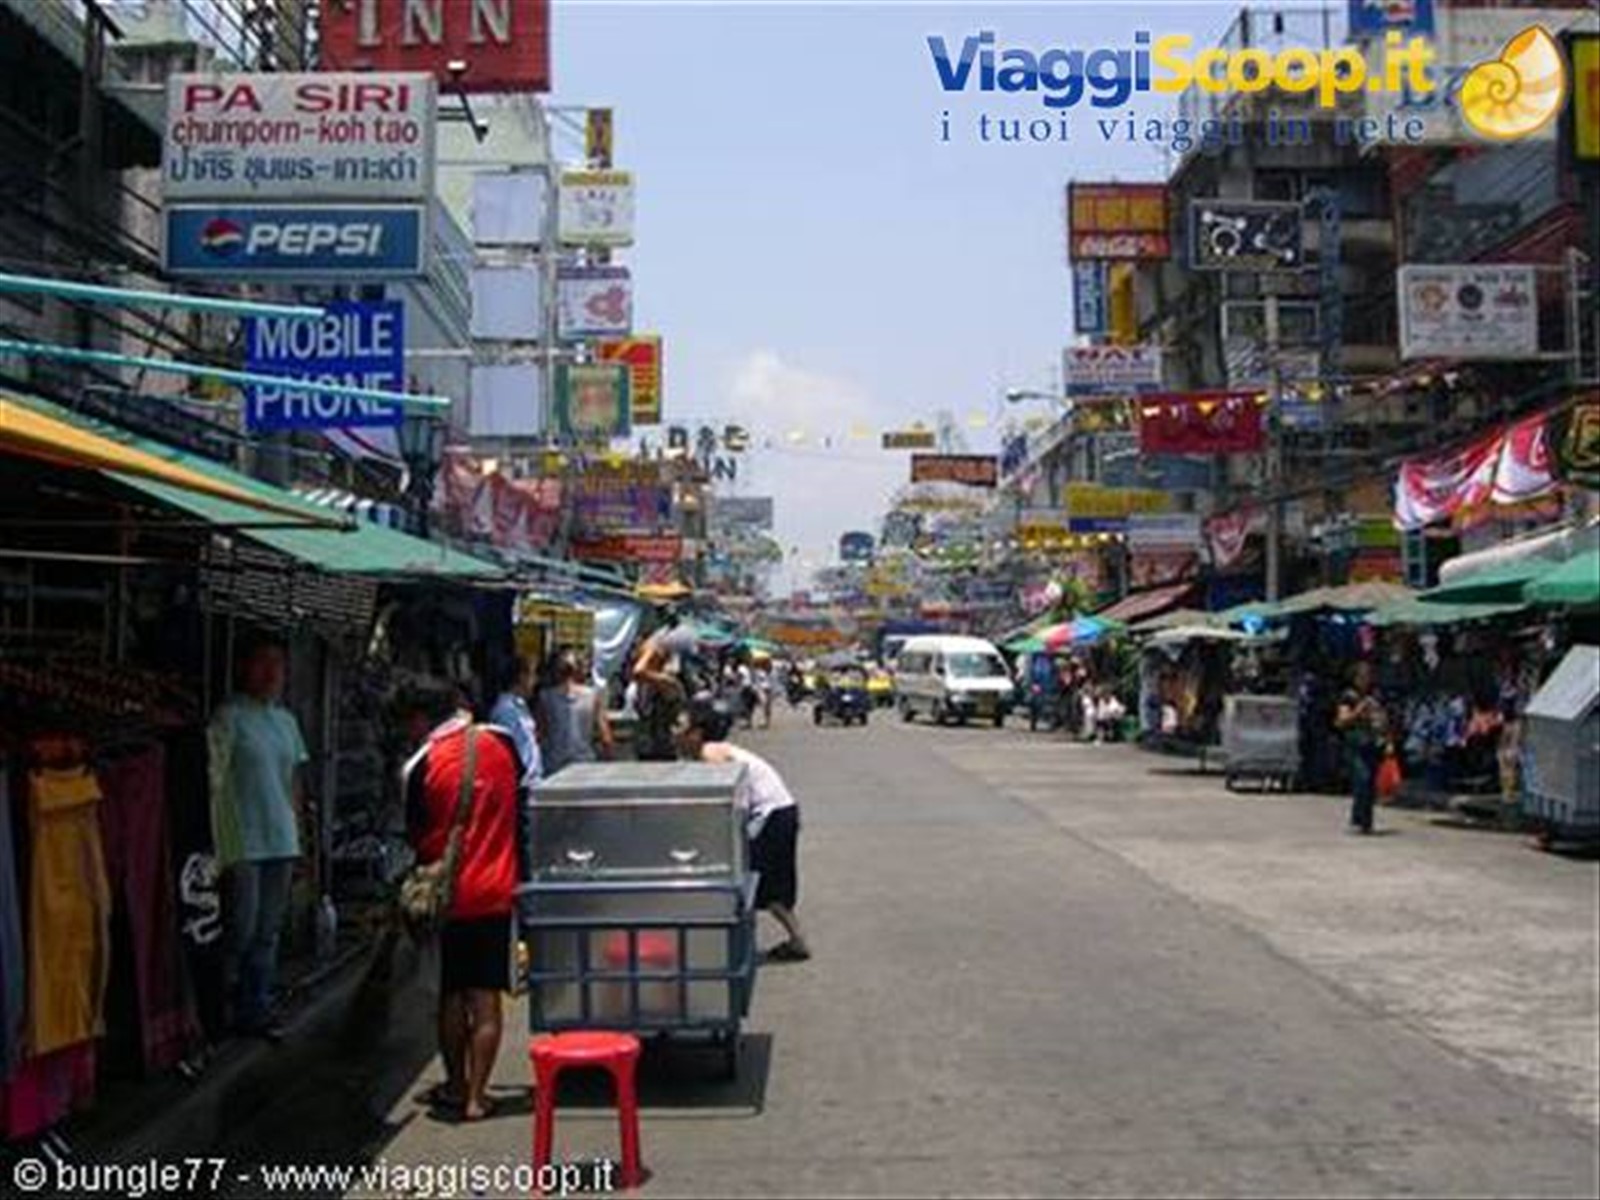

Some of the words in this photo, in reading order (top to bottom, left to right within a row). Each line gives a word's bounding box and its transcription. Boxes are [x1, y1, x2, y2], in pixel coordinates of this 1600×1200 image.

[359, 0, 510, 46] INN
[184, 84, 262, 113] PA
[295, 83, 411, 113] SIRI
[374, 117, 419, 143] tao
[247, 224, 383, 255] PEPSI
[255, 313, 393, 358] MOBILE
[256, 372, 393, 418] PHONE
